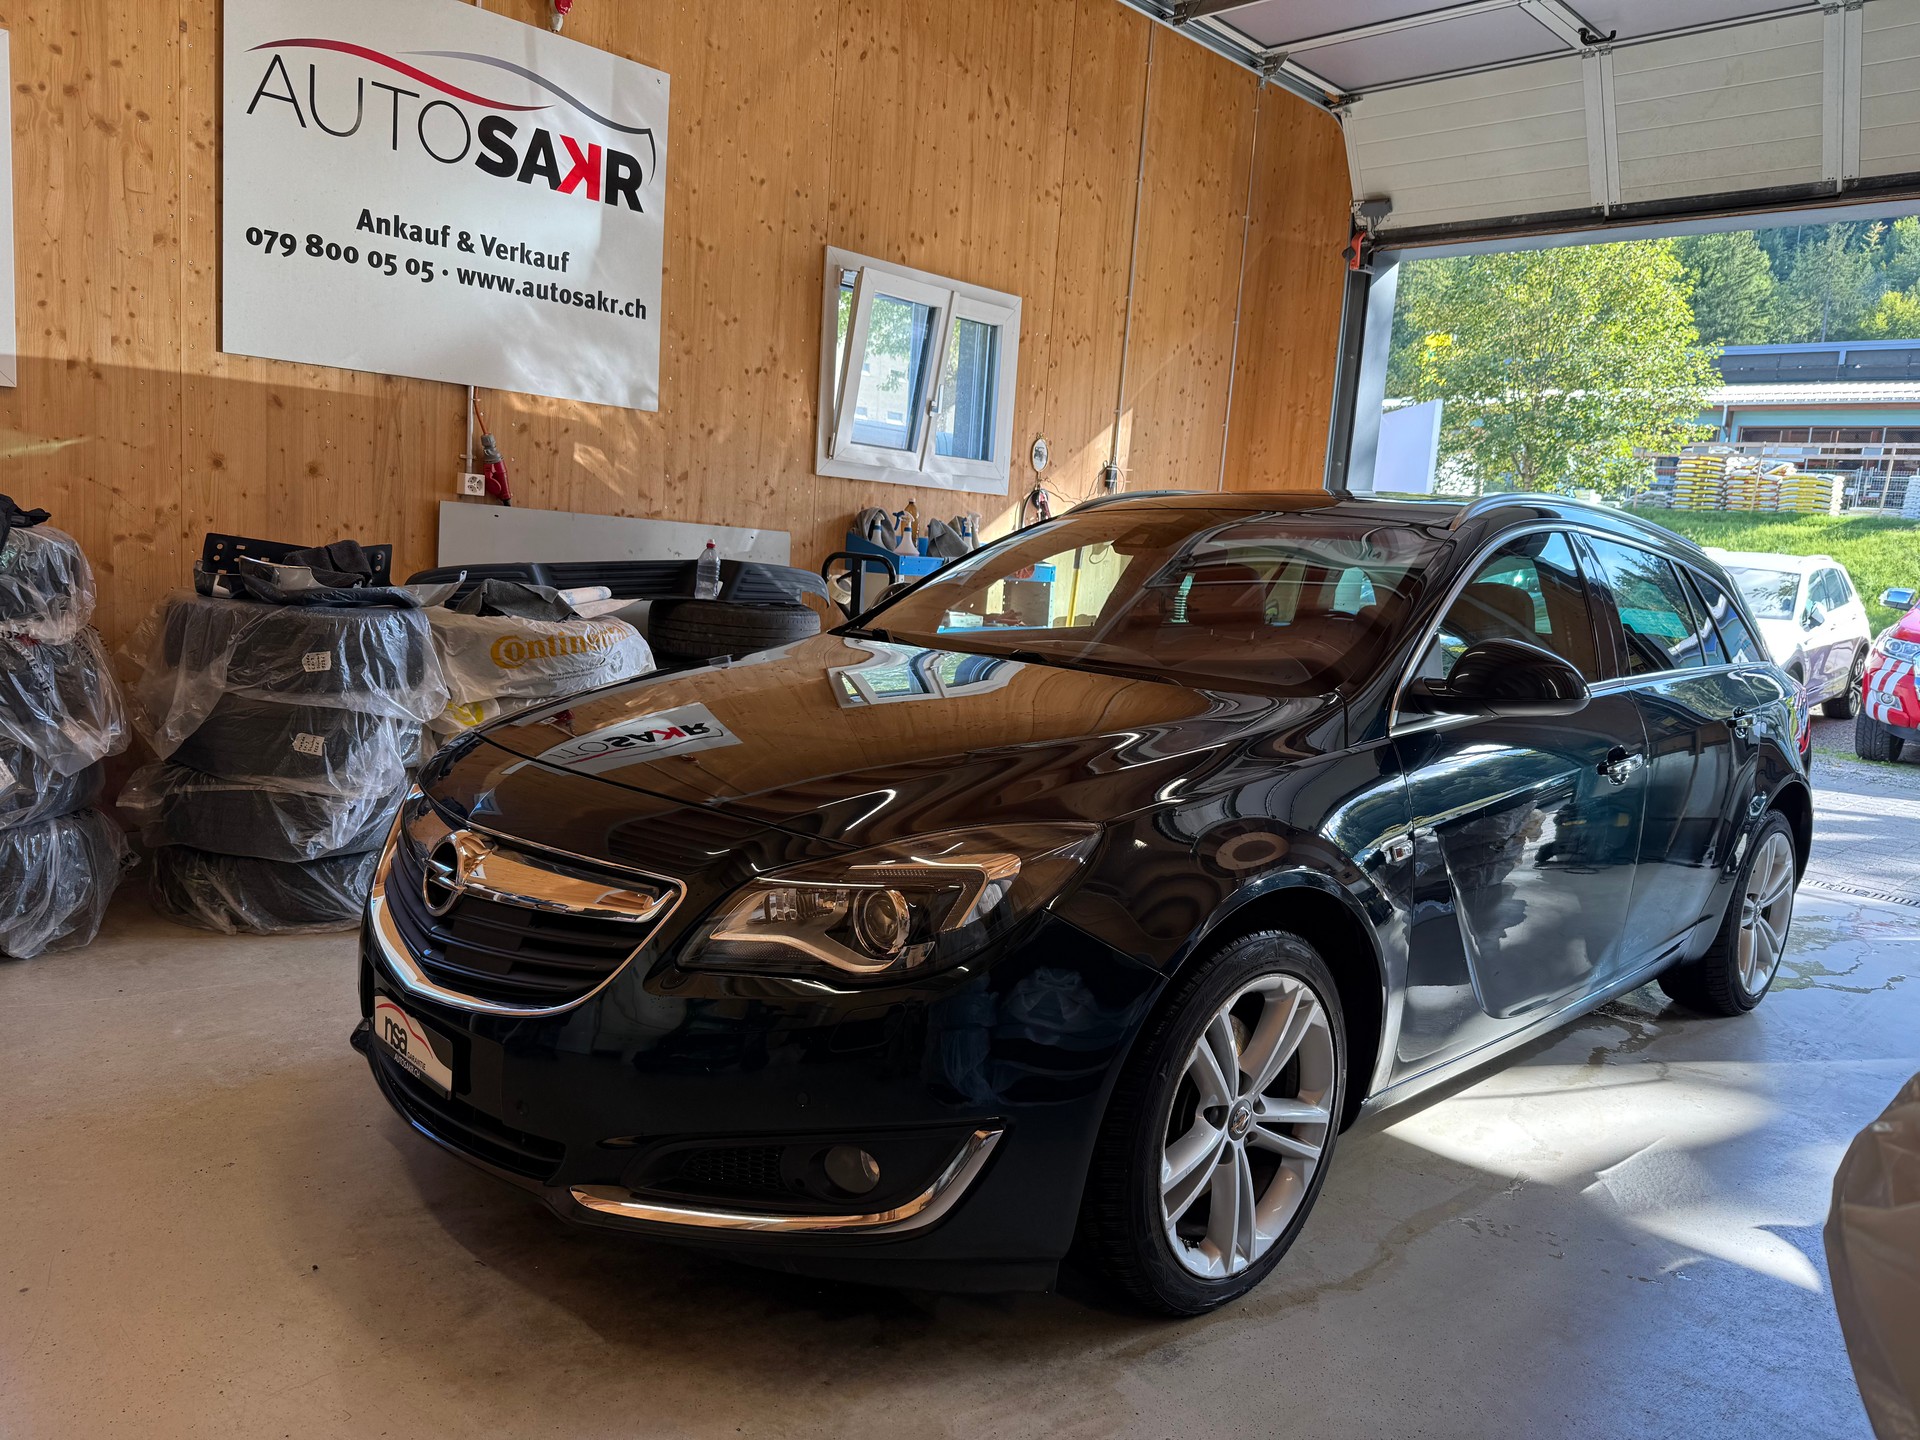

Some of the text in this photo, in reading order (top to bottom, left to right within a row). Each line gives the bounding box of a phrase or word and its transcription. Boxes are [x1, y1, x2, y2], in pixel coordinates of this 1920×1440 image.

[246, 53, 644, 214] AUTOSAKR
[245, 226, 297, 258] 079
[305, 233, 360, 264] 800
[367, 250, 398, 277] 05
[405, 258, 435, 283] 05
[456, 267, 648, 320] www.autosakr.ch
[355, 208, 571, 274] Ankauf & Verkauf
[491, 626, 632, 669] Continen
[385, 1016, 408, 1055] nsa
